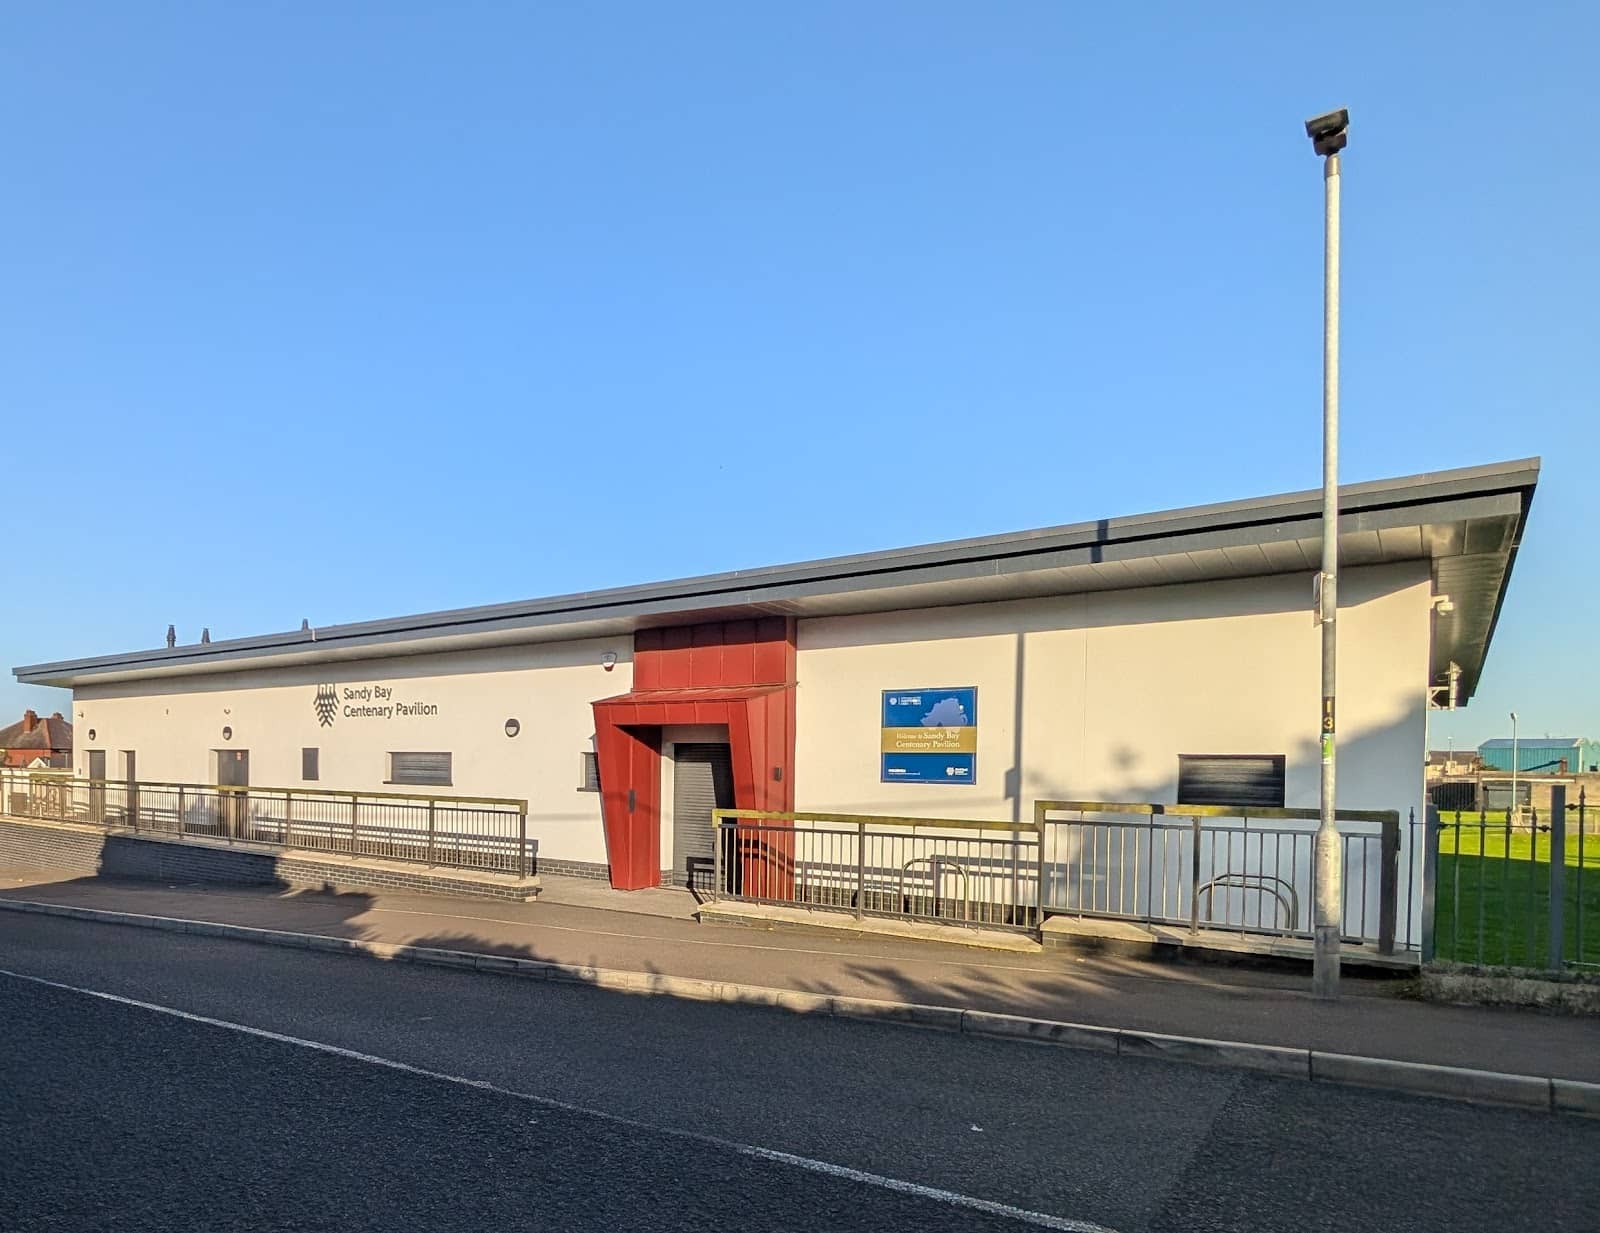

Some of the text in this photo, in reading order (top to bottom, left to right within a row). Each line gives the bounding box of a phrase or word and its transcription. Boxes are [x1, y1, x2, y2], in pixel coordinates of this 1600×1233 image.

[343, 685, 393, 702] Sandy Bay
[343, 701, 438, 719] Centenary Pavilion
[923, 731, 945, 741] Sandy
[896, 740, 960, 750] Centenary Pavilion
